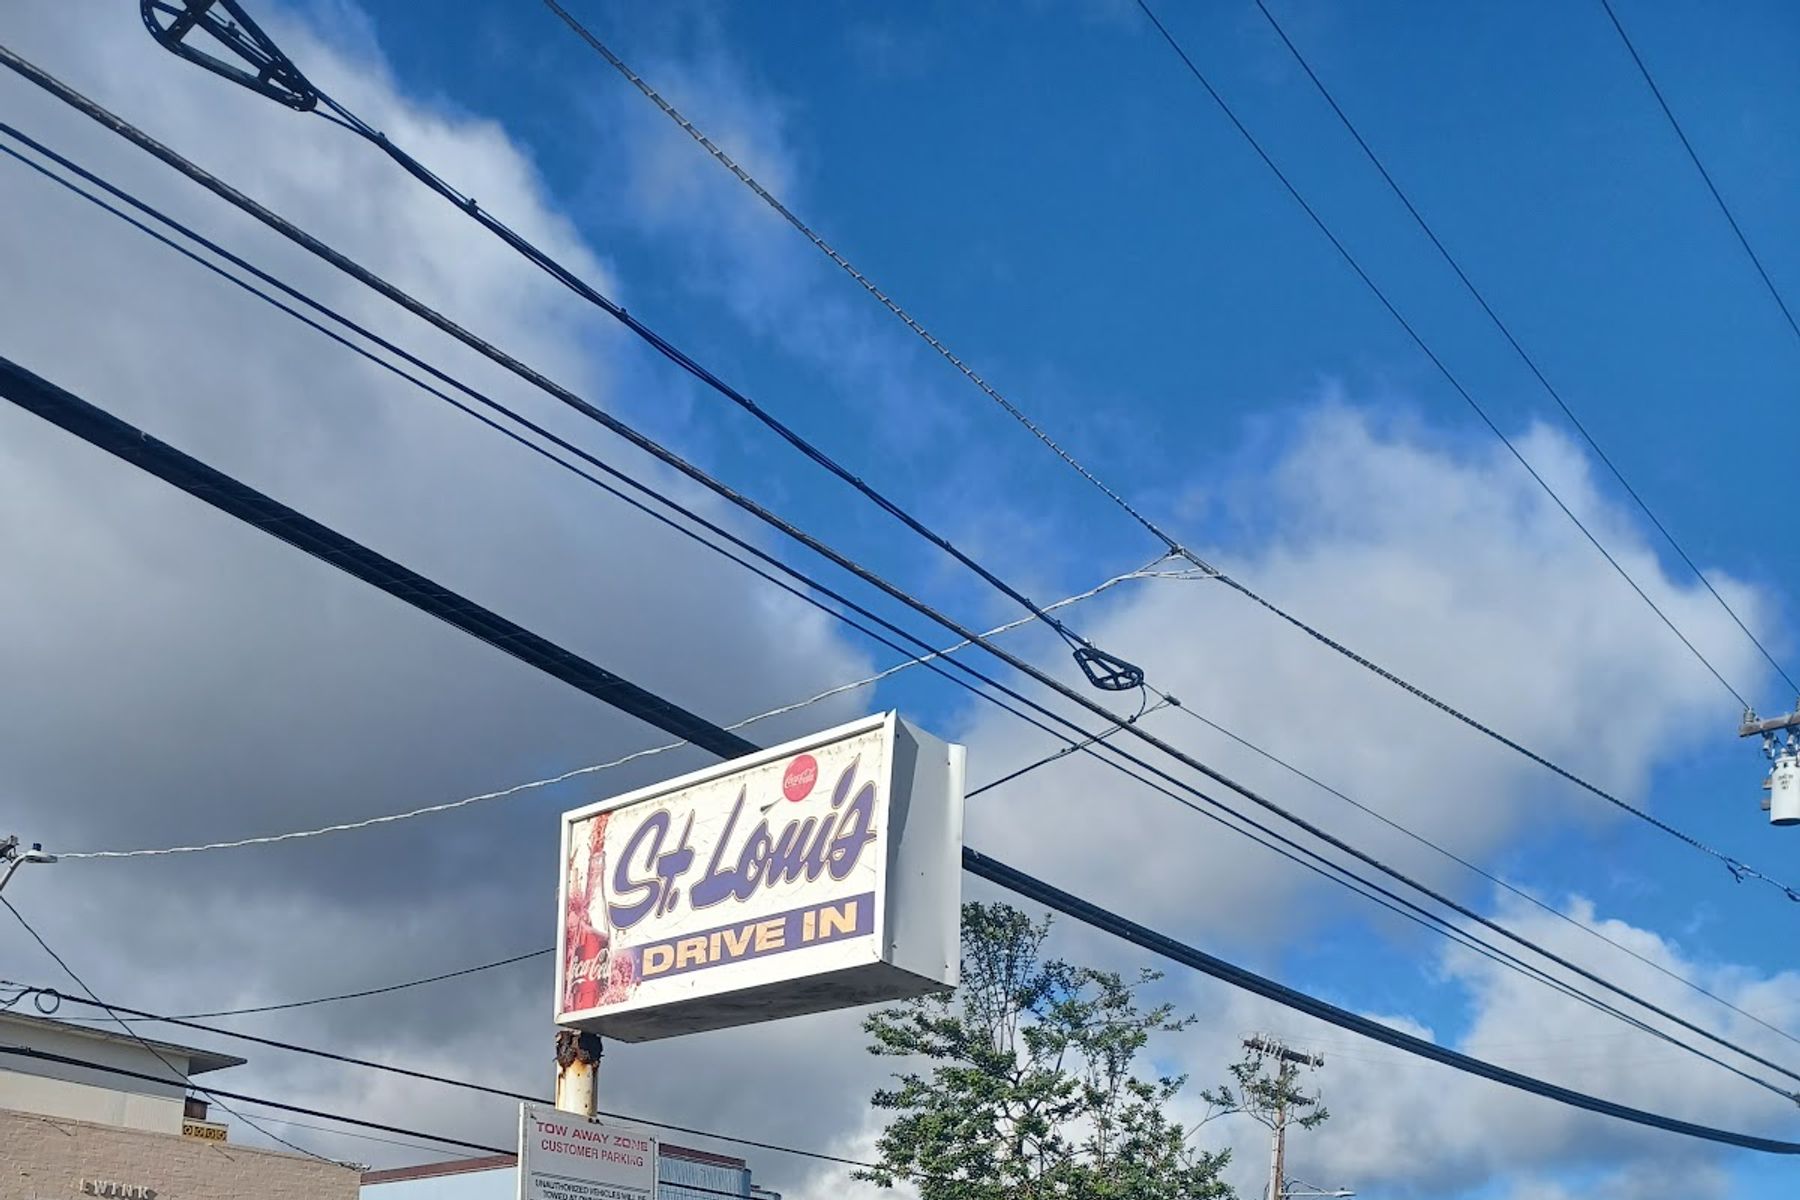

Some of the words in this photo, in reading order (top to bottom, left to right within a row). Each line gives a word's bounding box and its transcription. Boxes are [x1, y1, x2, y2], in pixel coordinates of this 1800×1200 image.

[642, 917, 787, 976] DRIVE
[802, 900, 859, 943] IN
[536, 1121, 568, 1137] TOW
[572, 1128, 609, 1144] AWAY
[613, 1135, 649, 1152] ZONE
[541, 1139, 599, 1159] CUSTOMER
[601, 1149, 644, 1167] PARKING
[535, 1178, 589, 1194] UNAUTHORIZED
[589, 1186, 621, 1200] VEHICLES
[543, 1189, 568, 1200] TOWED
